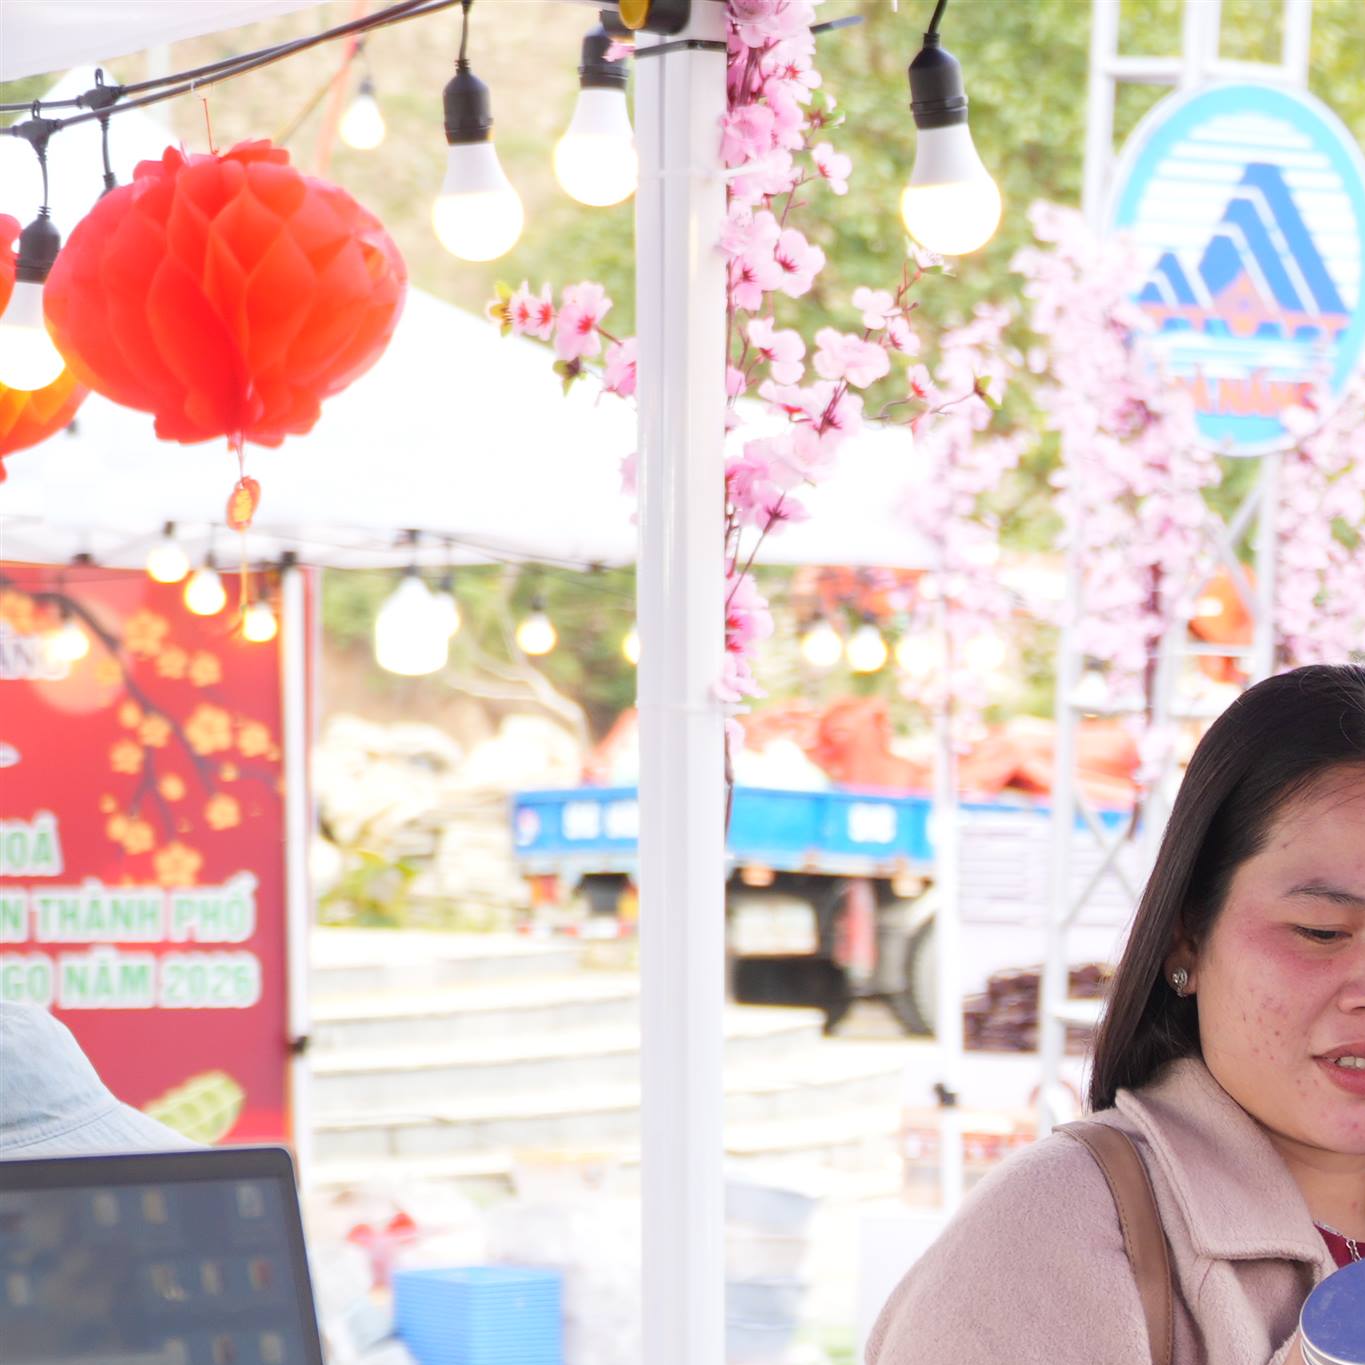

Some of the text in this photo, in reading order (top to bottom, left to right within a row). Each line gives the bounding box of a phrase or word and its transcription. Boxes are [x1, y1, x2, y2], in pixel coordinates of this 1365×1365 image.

[0, 815, 55, 870] OÁ
[38, 884, 160, 937] THÀNH
[62, 950, 155, 998] NĂM
[163, 960, 255, 1000] 2026
